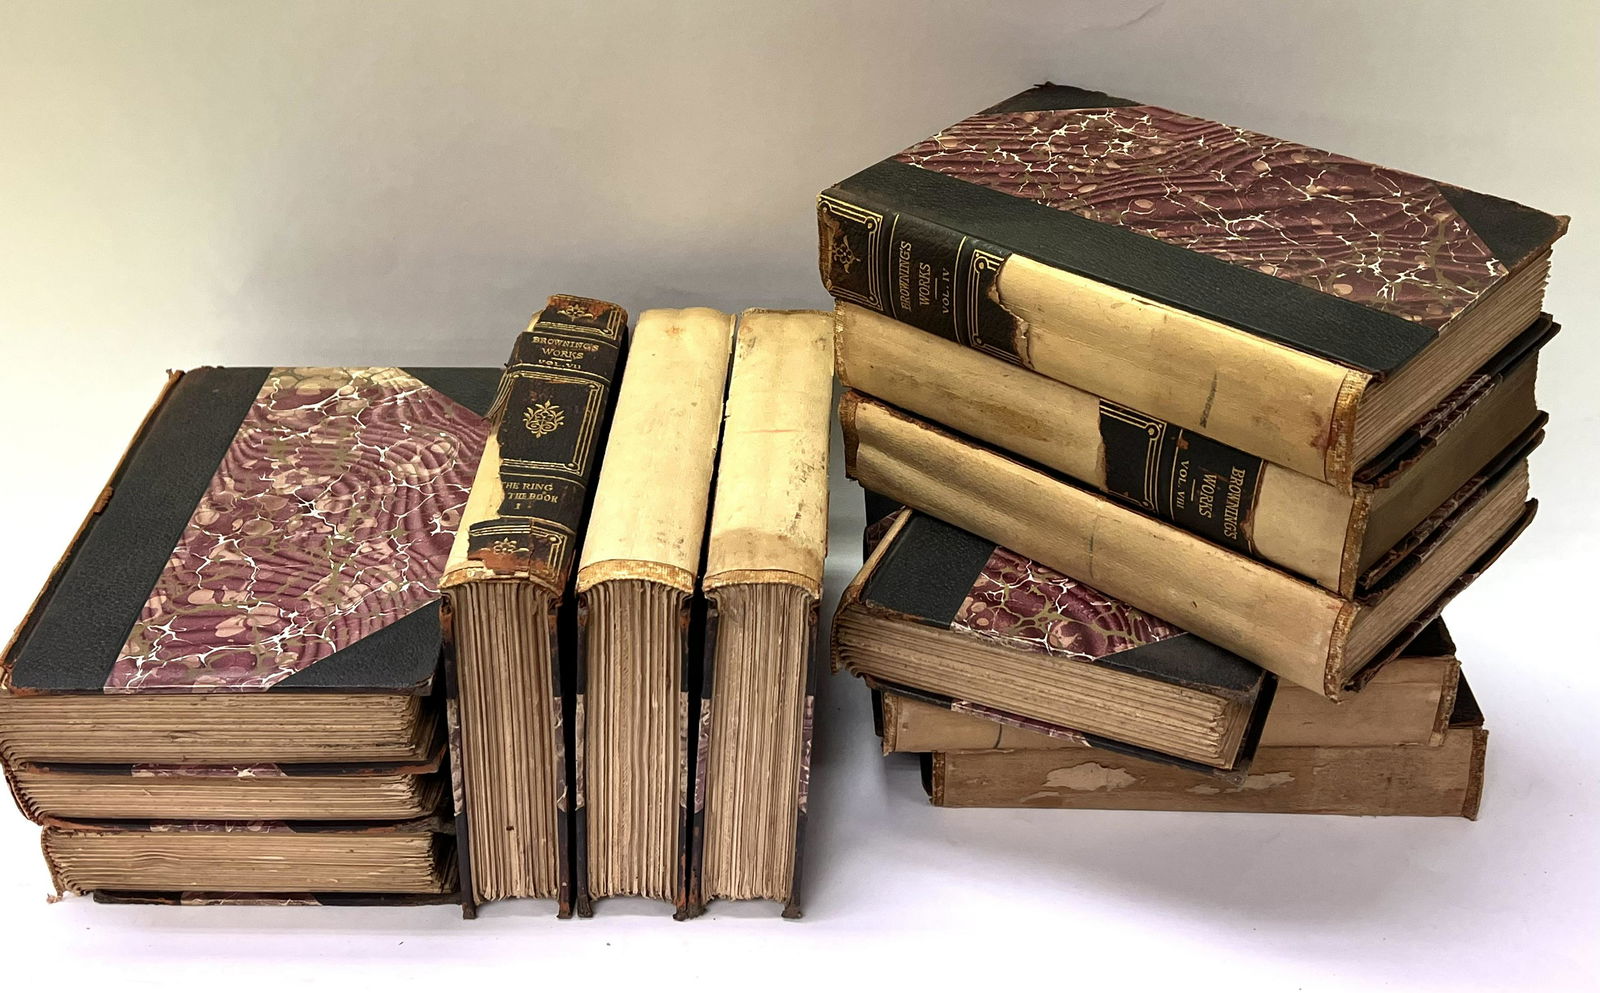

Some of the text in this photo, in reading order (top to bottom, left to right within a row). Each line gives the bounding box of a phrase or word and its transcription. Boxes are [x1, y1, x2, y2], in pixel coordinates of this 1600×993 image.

[919, 262, 931, 306] WORKS
[942, 267, 951, 314] VOL. IV
[541, 347, 584, 360] WORKS
[507, 492, 559, 504] THE BOOK
[522, 482, 554, 492] RING
[1176, 460, 1190, 510] VOL. VIII
[1199, 473, 1217, 519] WORKS
[1223, 465, 1246, 540] BROWNING'S
